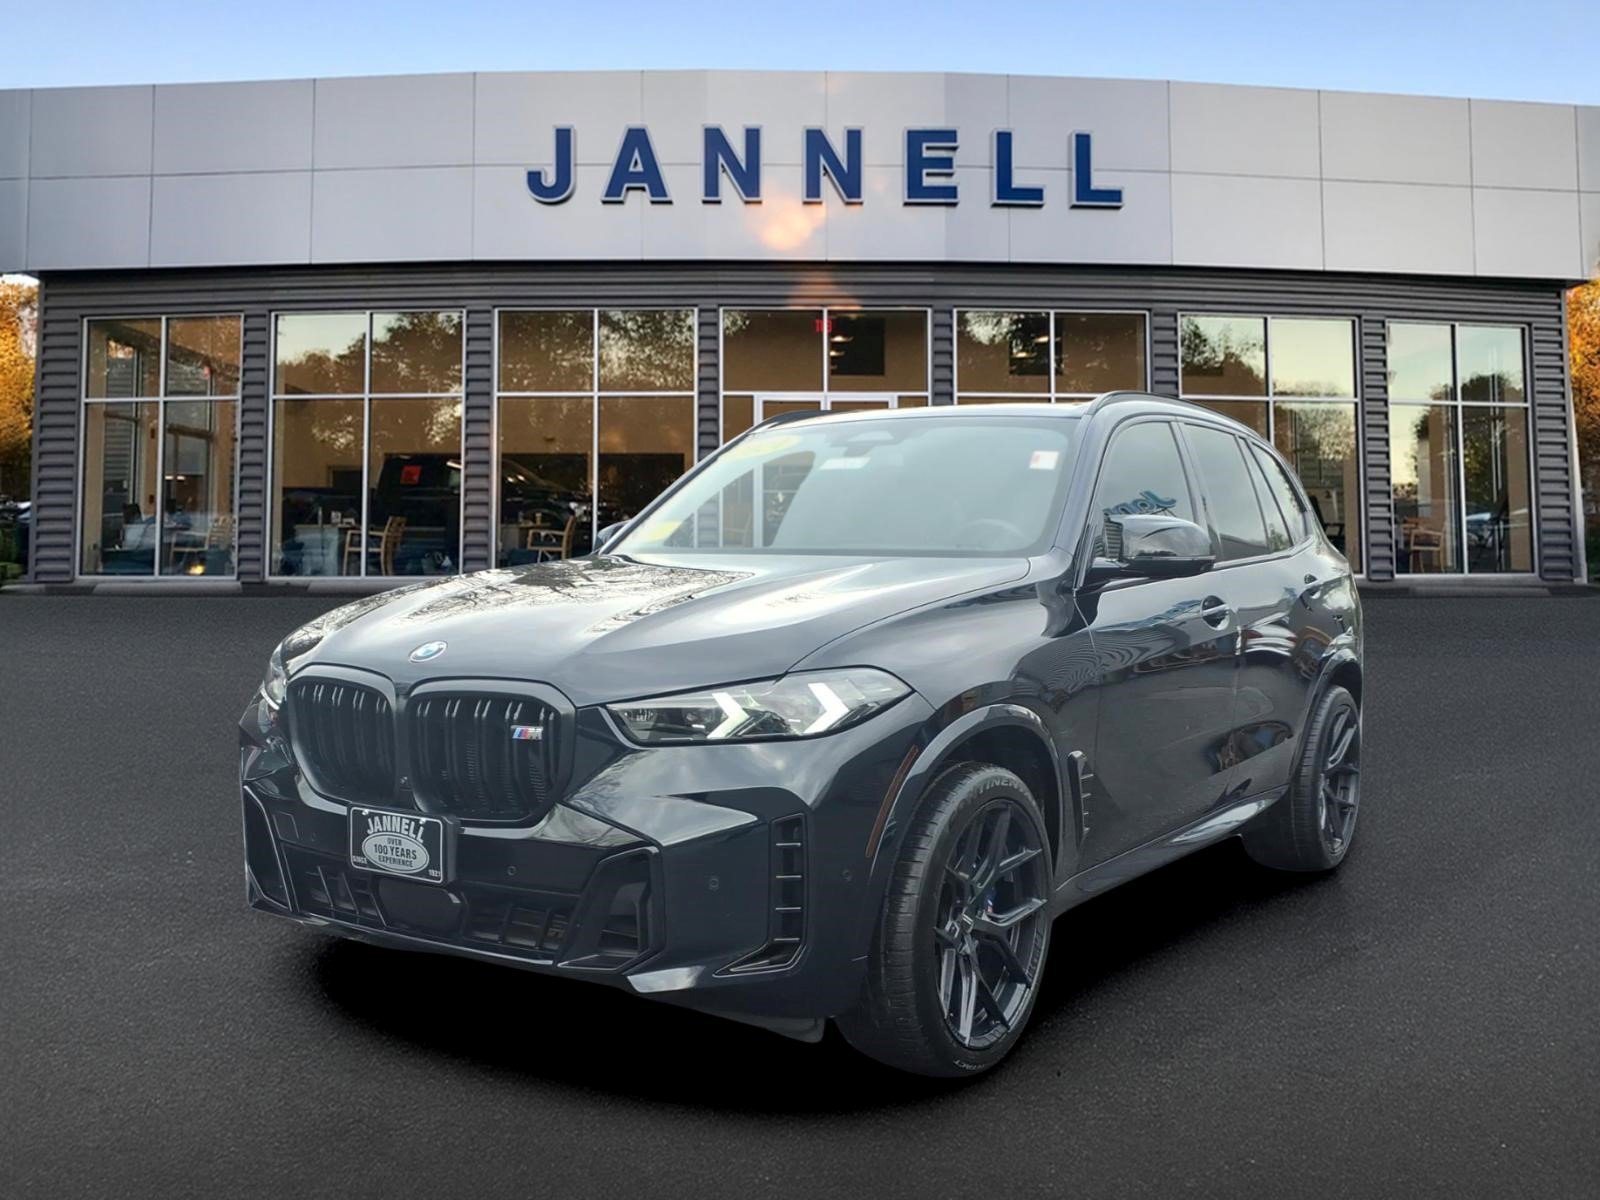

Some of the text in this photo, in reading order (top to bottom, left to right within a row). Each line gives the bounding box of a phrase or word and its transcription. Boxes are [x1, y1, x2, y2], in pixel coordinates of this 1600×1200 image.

[526, 125, 1124, 208] JANNELL
[367, 815, 424, 843] JANNELL
[374, 844, 417, 860] 100 YEARS
[378, 855, 413, 868] EXPERIENCE
